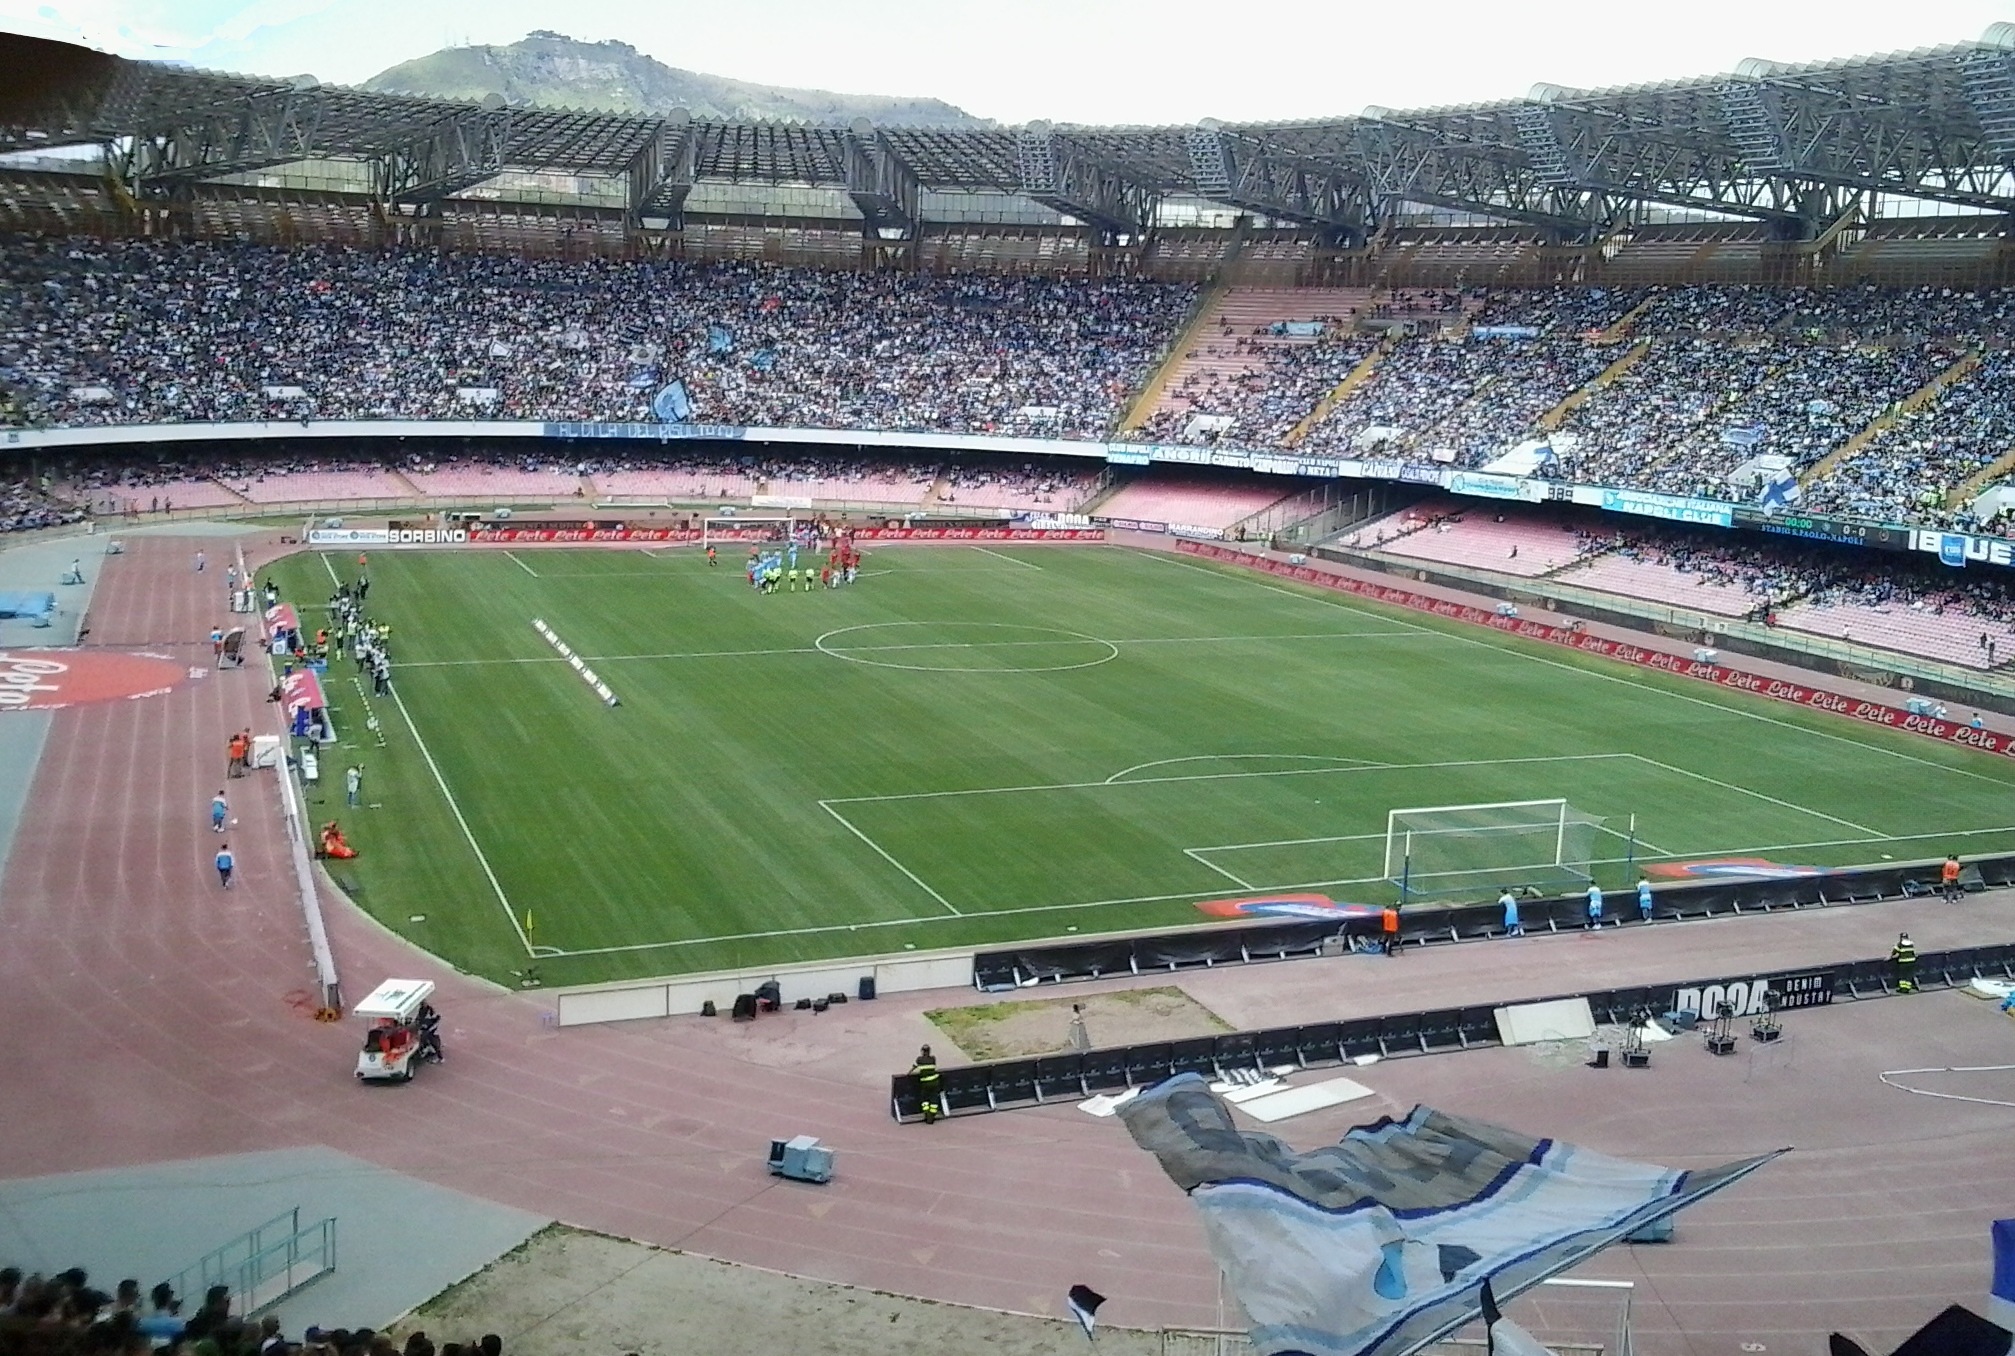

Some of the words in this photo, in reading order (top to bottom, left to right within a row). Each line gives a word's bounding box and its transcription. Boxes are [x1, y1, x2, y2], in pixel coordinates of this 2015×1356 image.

[1785, 517, 1812, 529] 00:00
[389, 529, 465, 543] SORBINO
[1579, 636, 1609, 653] Lete
[1614, 644, 1644, 662] Lete
[1649, 653, 1680, 671] Lete
[1686, 661, 1719, 680] Lete
[1723, 671, 1760, 690] Lete
[1764, 680, 1802, 700] Lete
[1808, 692, 1847, 712] Lete
[1853, 702, 1894, 724] Lete
[1900, 714, 1945, 736] Lete
[1950, 726, 1996, 750] Lete
[1786, 977, 1822, 992] DENIM
[1781, 990, 1832, 1007] NDUSTRY
